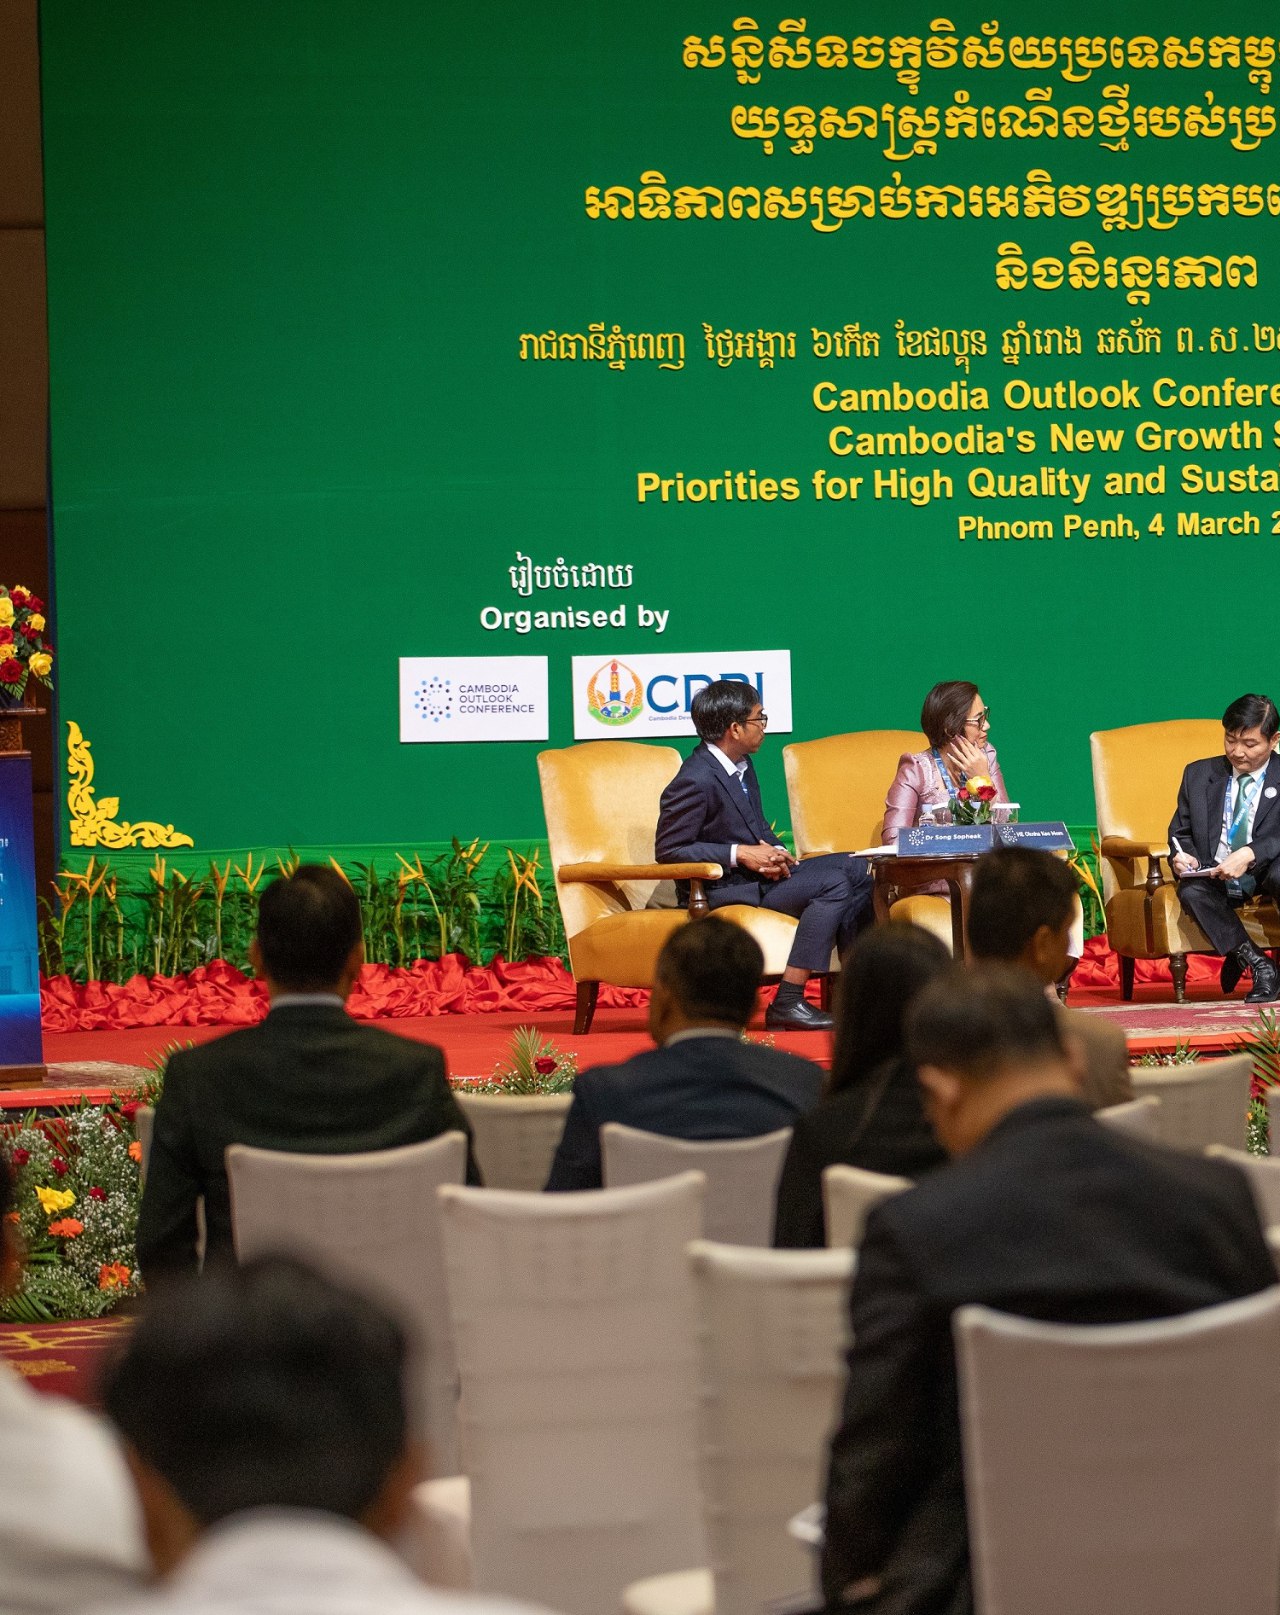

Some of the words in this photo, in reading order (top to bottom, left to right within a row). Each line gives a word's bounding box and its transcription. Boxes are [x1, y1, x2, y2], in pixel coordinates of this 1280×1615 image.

[518, 321, 686, 371] រាជធានីភ្នំពេញ
[701, 322, 797, 369] ថ្ងៃអង្គារ
[1001, 320, 1082, 365] ឆ្នាំរោង
[812, 380, 990, 412] Cambodia
[1003, 379, 1141, 410] Outlook
[828, 423, 1036, 456] Cambodia's
[1050, 423, 1125, 452] New
[1135, 420, 1263, 451] Growth
[637, 469, 801, 502] Priorities
[811, 469, 864, 500] for
[873, 467, 953, 506] High
[967, 466, 1091, 505] Quality
[1104, 464, 1166, 495] and
[958, 515, 1054, 540] Phnom
[1063, 513, 1140, 541] Penh,
[1148, 512, 1165, 536] 4
[1177, 510, 1260, 536] March
[508, 551, 634, 597] រៀបចំដោយ
[480, 604, 626, 634] Organised
[637, 604, 670, 633] by
[459, 684, 519, 693] CAMBODIA
[459, 695, 513, 703] OUTLOOK
[646, 672, 764, 713] CDI
[459, 704, 535, 713] CONFERENCE
